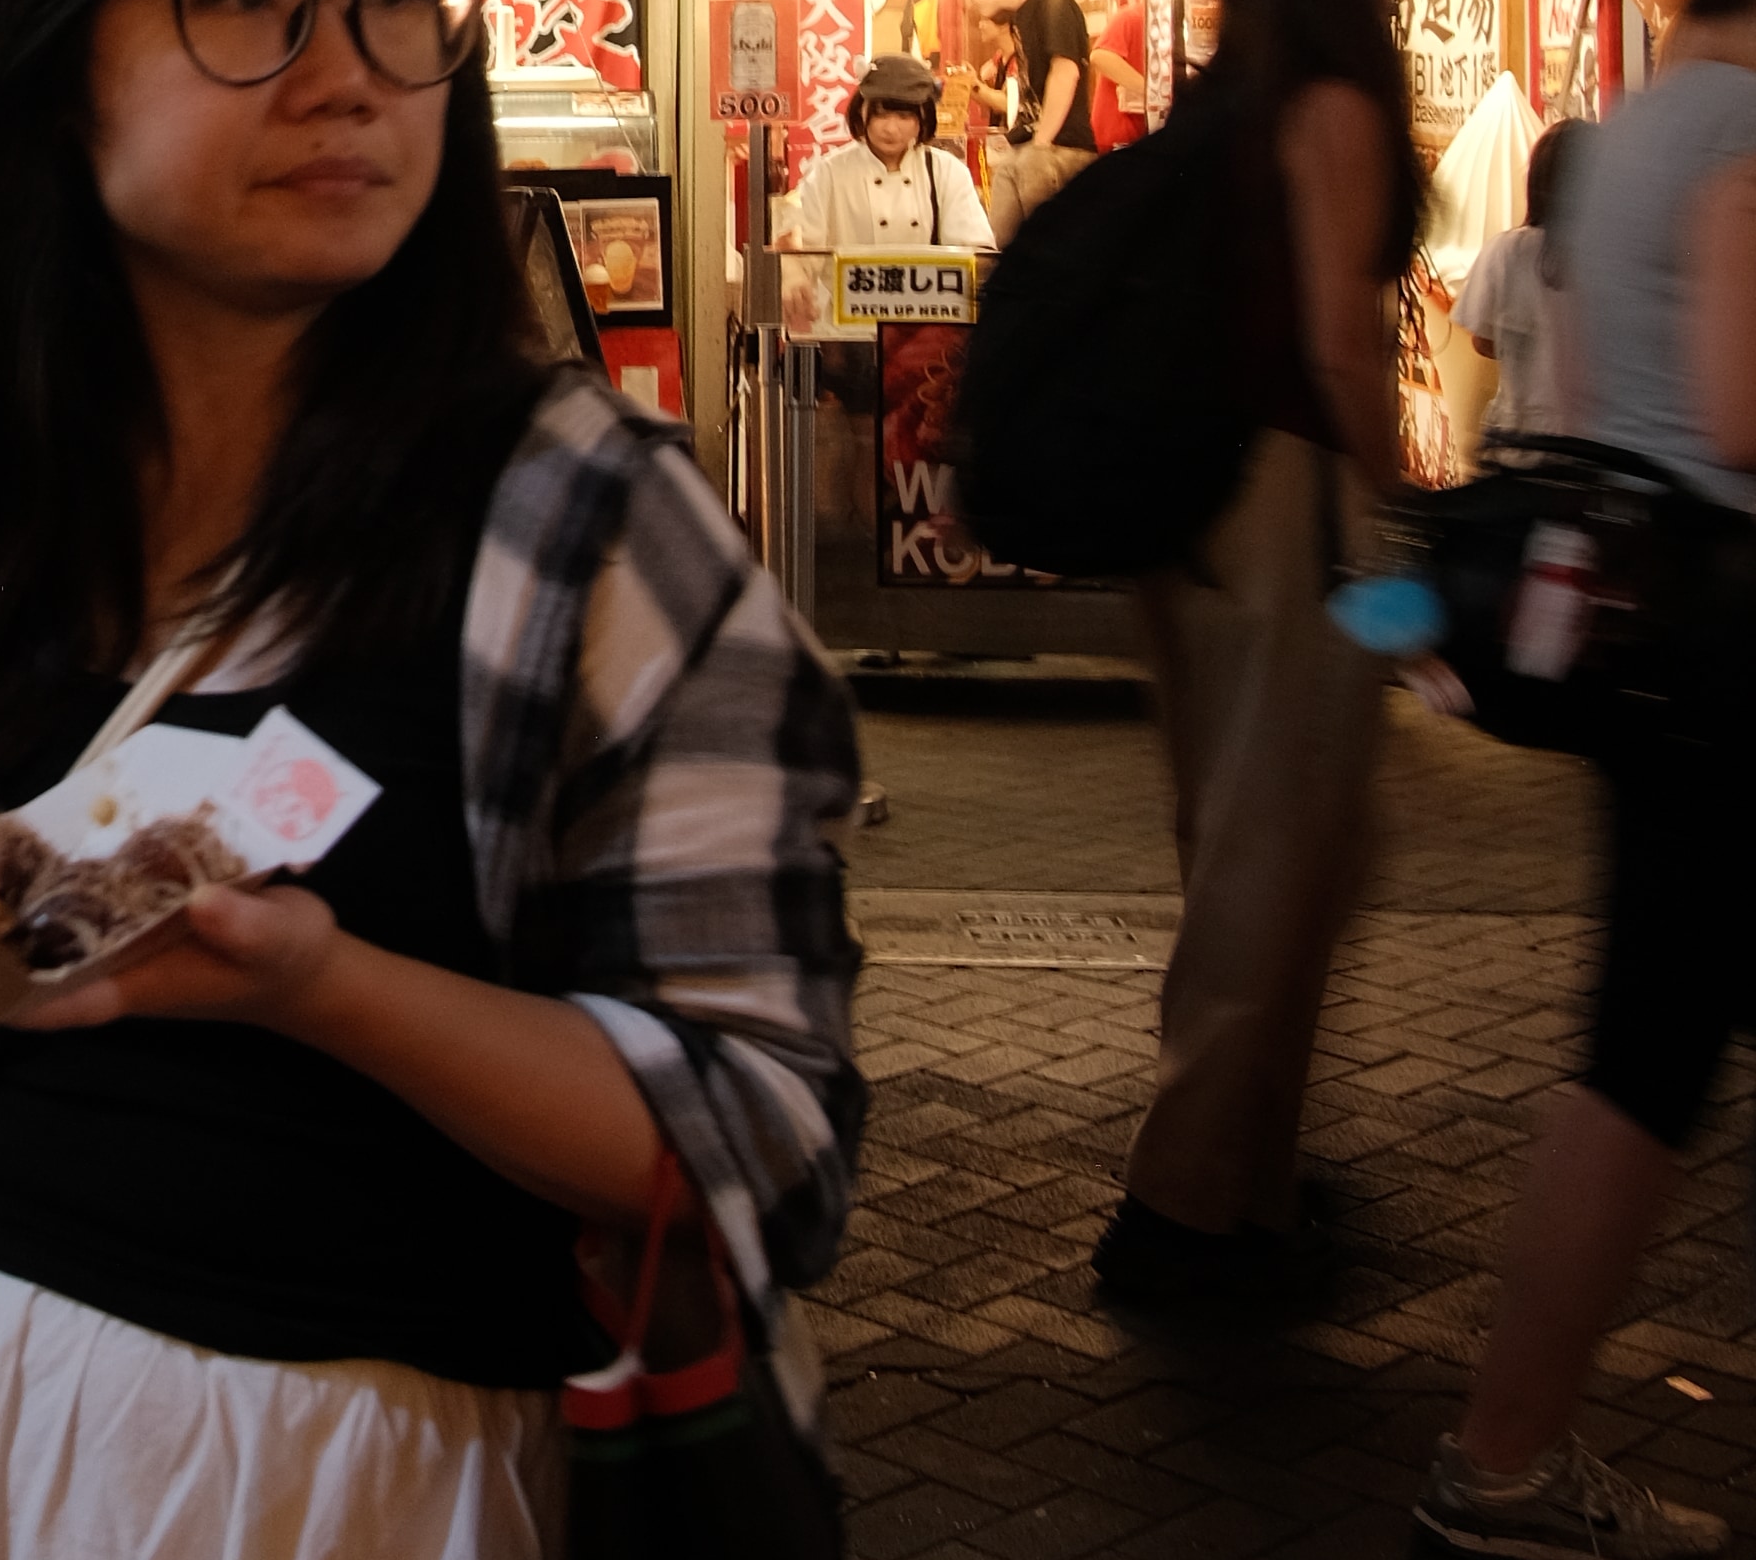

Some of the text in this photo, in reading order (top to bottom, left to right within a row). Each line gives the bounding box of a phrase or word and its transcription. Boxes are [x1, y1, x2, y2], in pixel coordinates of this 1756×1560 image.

[717, 91, 782, 118] 500
[848, 265, 963, 294] お渡し口
[850, 304, 961, 317] PICK UP HERE
